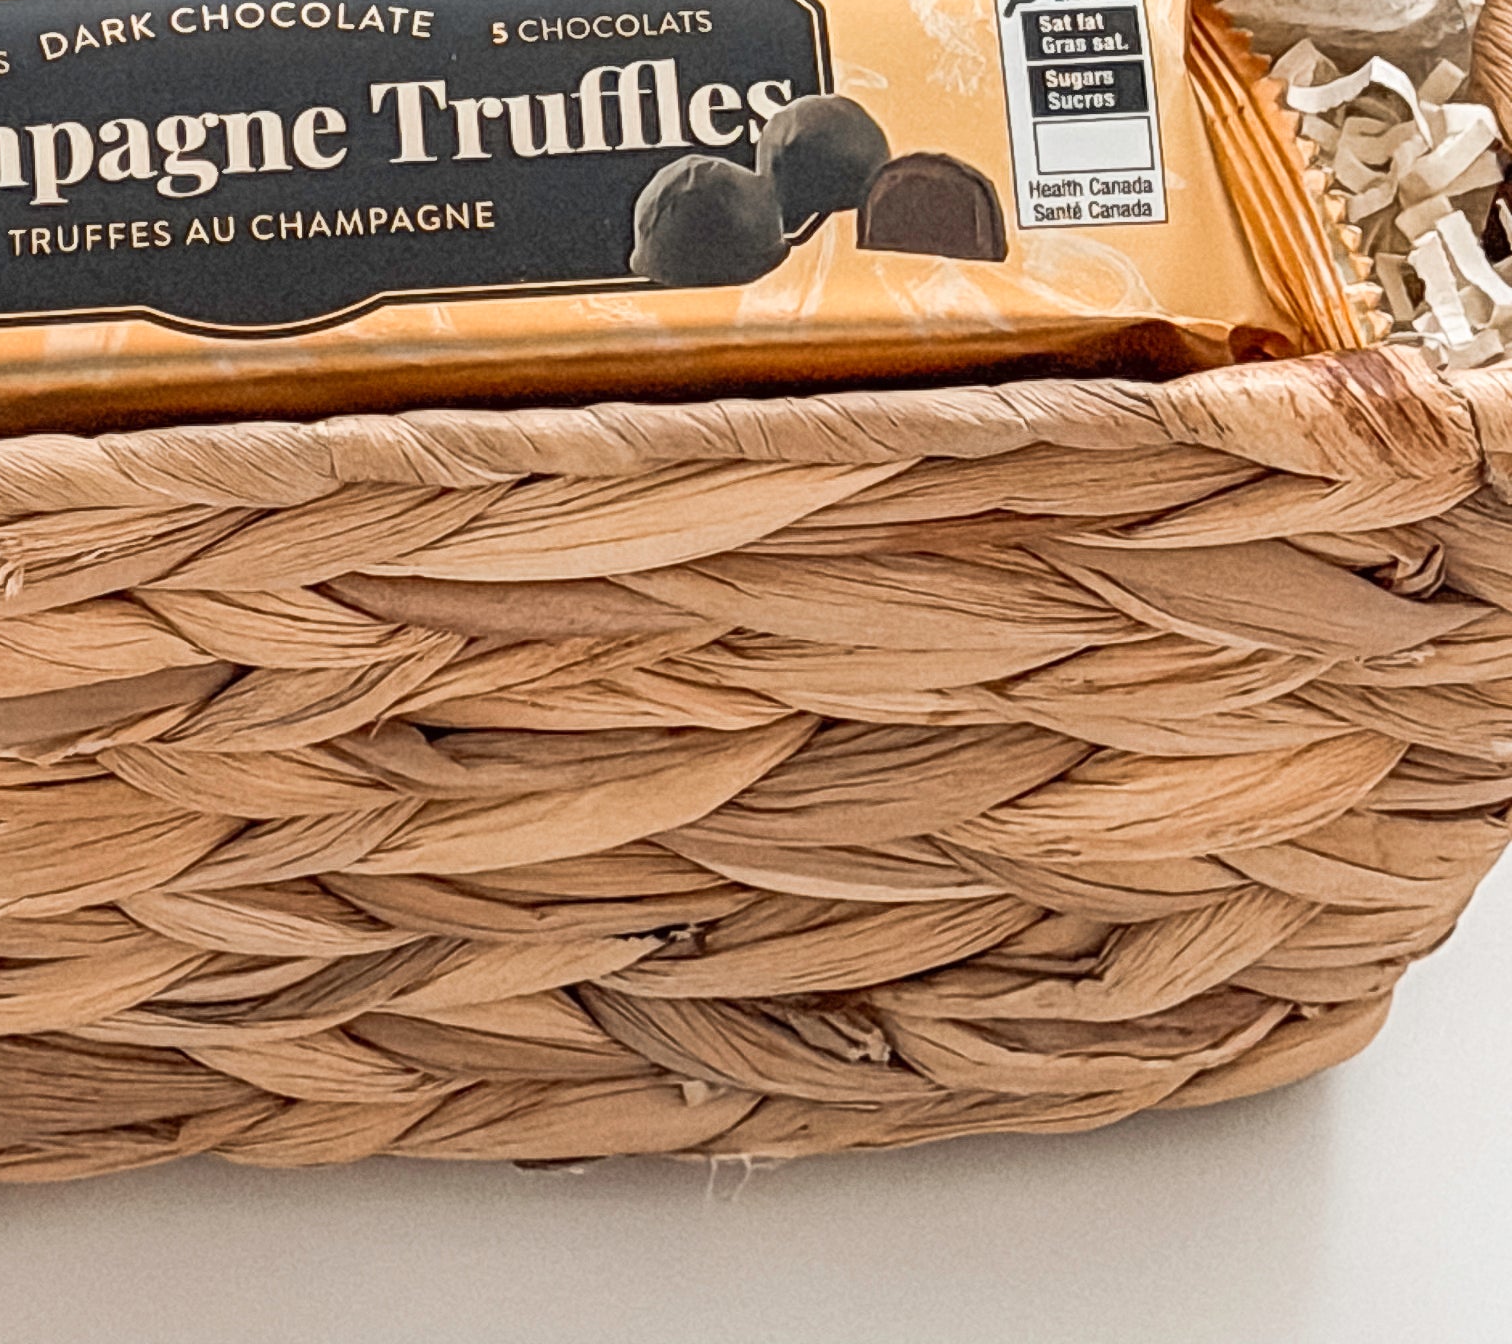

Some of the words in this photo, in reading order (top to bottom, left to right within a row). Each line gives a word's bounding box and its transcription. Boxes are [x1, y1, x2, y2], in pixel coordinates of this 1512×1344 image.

[39, 11, 155, 63] DARK
[170, 1, 435, 40] CHOCOLATE
[491, 21, 509, 44] 5
[518, 9, 713, 44] CHOCOLATS
[1039, 15, 1072, 33] Sat
[1046, 69, 1115, 91] Sugars
[372, 58, 796, 165] Truffles
[1029, 179, 1083, 200] Health
[1089, 176, 1154, 196] Canada
[1034, 200, 1083, 223] Santé
[1088, 198, 1153, 219] Canada
[9, 220, 171, 257] TRUFFES
[185, 215, 236, 248] AU
[250, 201, 496, 242] CHAMPAGNE
